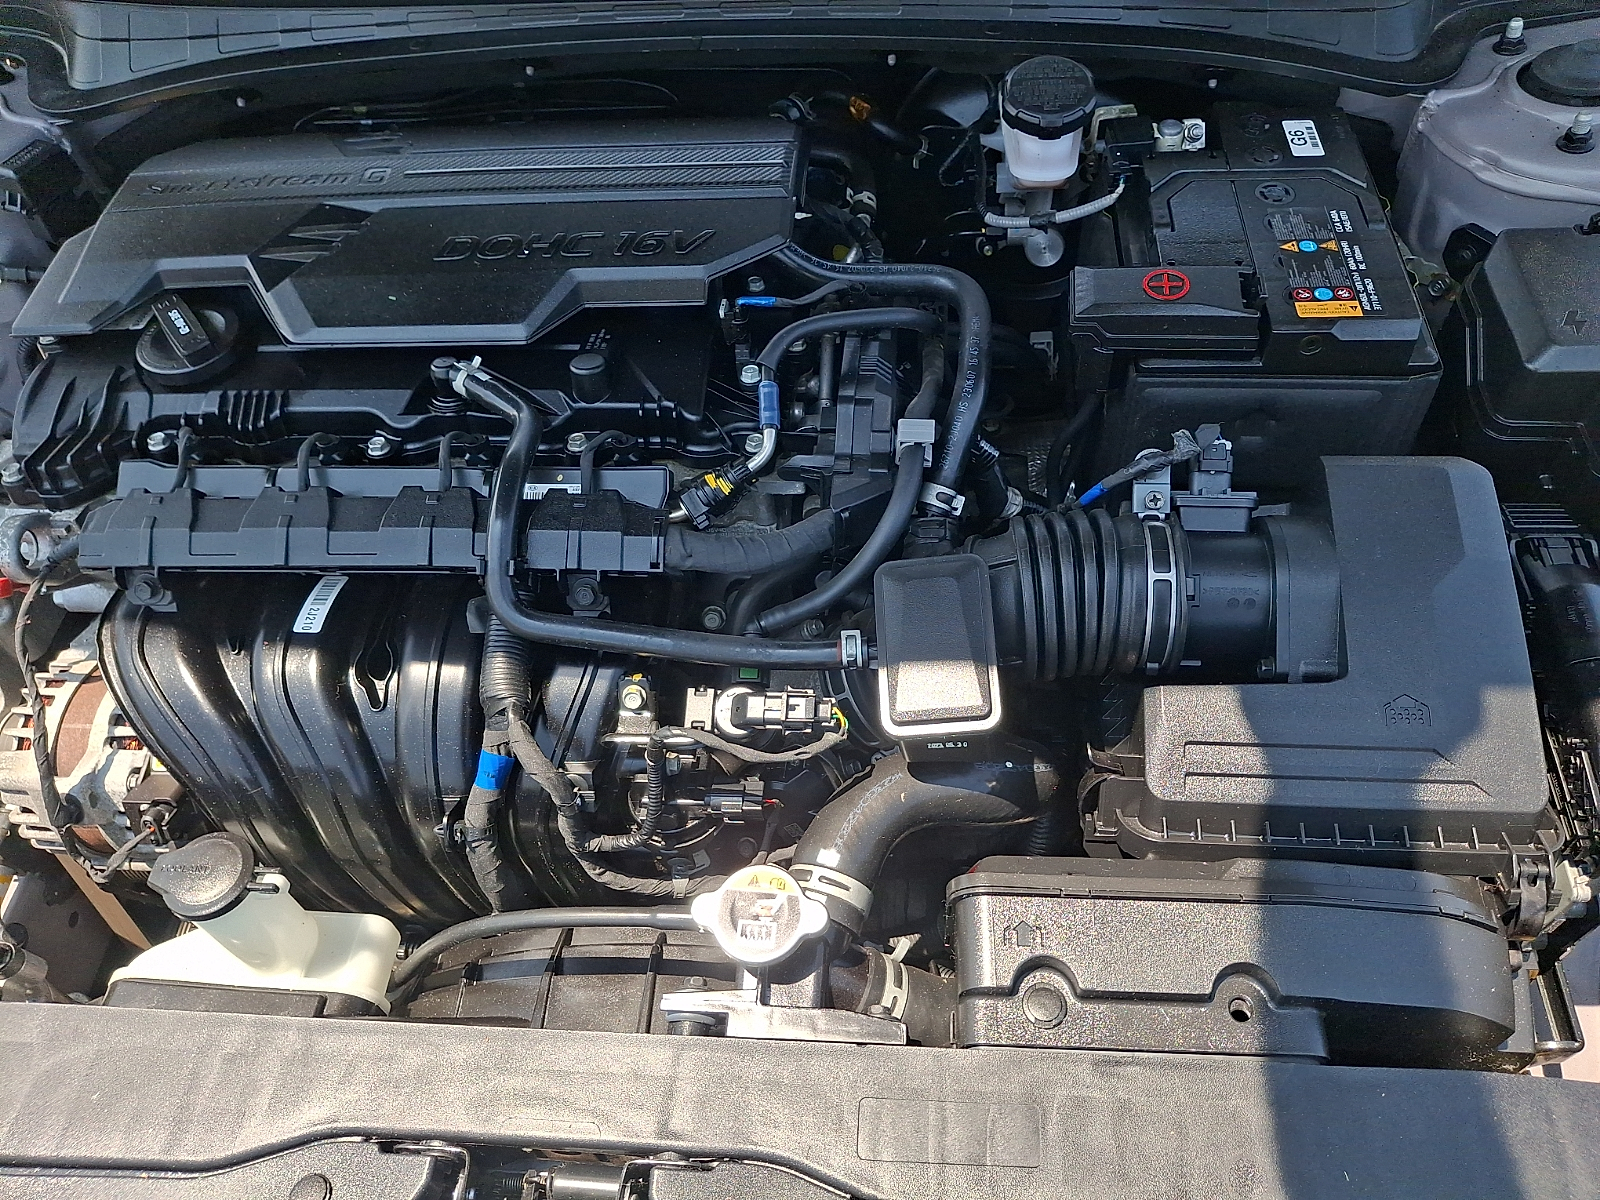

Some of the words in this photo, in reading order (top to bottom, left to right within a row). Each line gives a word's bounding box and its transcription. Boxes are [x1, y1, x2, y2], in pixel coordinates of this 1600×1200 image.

[1288, 130, 1307, 146] G6
[148, 172, 351, 195] Smartstream
[433, 232, 604, 260] DOHC
[614, 230, 716, 256] 16V
[962, 370, 977, 398] 230607
[957, 401, 969, 414] HS
[939, 416, 964, 469] 26710-2J040
[301, 607, 321, 631] 2J210
